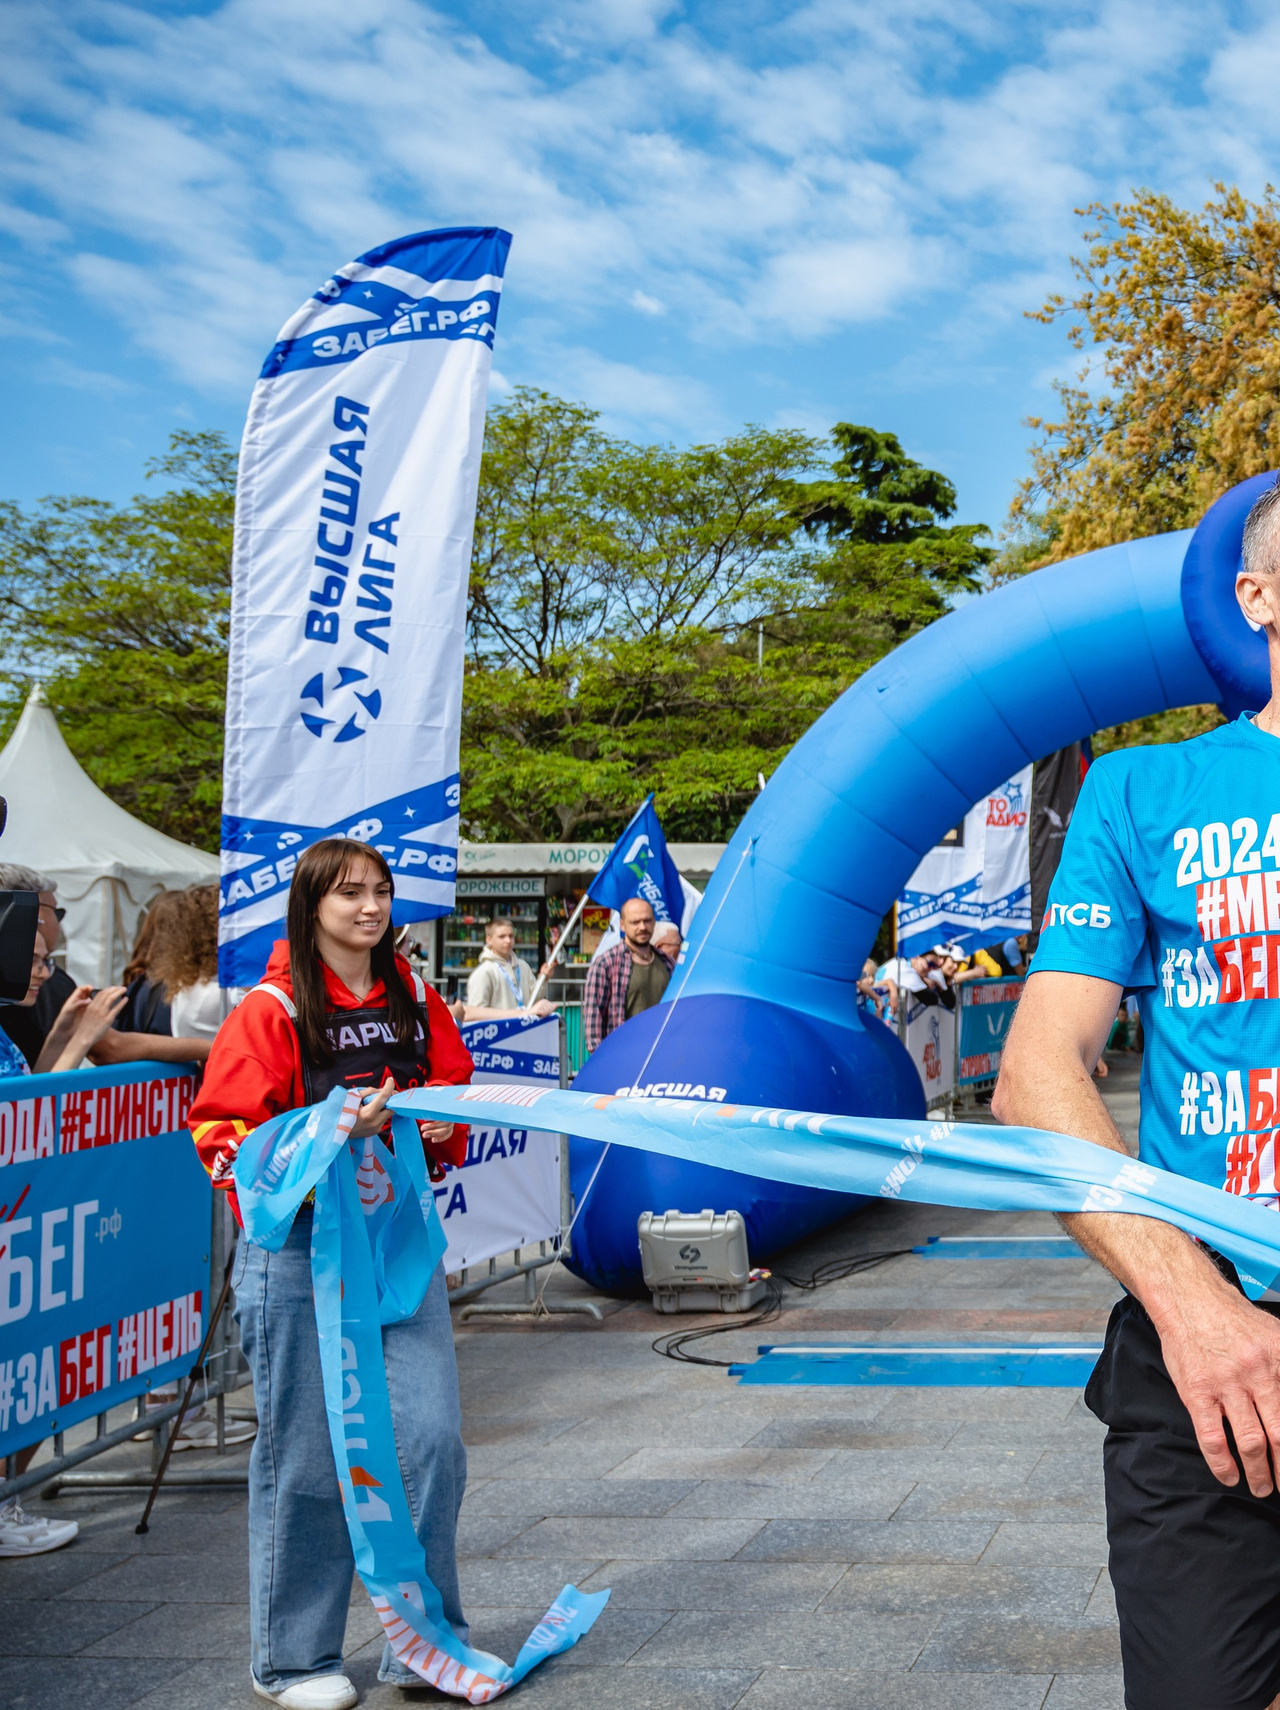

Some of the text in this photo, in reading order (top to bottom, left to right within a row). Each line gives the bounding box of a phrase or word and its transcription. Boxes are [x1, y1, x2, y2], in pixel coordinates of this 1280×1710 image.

[304, 396, 370, 644] ВЫСШАЯ
[354, 511, 401, 655] ЛИГА
[1049, 903, 1111, 928] ПСБ
[615, 1083, 728, 1101] ВЫСШАЯ
[117, 1291, 202, 1382] #ЦЕЛЬ
